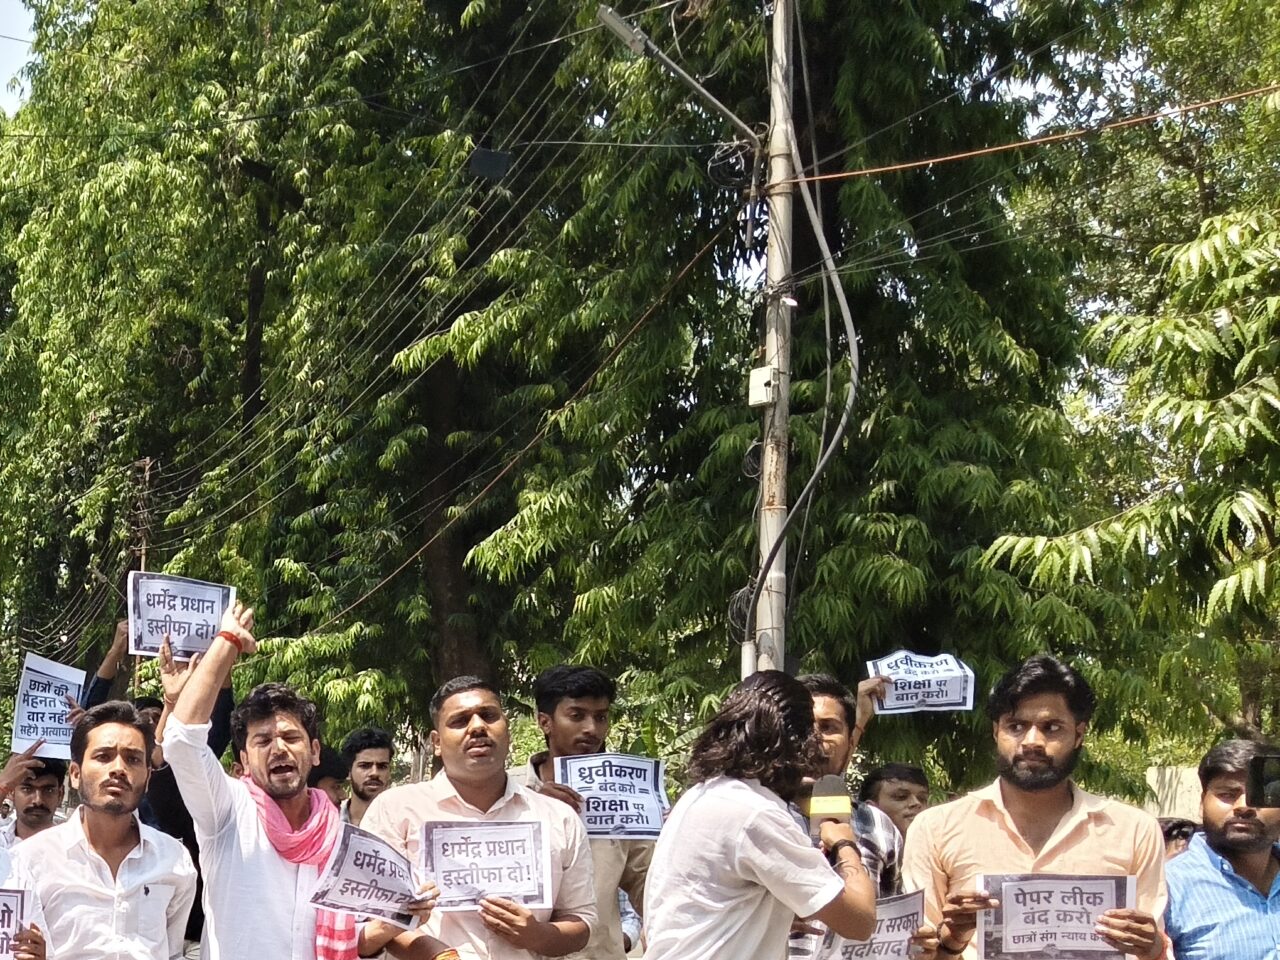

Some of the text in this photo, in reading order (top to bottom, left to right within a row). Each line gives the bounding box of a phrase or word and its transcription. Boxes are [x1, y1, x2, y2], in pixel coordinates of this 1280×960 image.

[146, 589, 215, 614] धर्मेंद्र प्रधान
[147, 614, 216, 640] इस्तीफा दो!
[29, 679, 70, 697] छात्रों की
[894, 678, 947, 691] शिक्षा पर
[22, 689, 56, 708] मेहनत
[895, 691, 920, 701] बात
[26, 711, 46, 722] वार
[578, 760, 647, 784] ध्रुवीकरण
[598, 780, 636, 794] बंद करो
[585, 796, 645, 812] शिक्षा पर
[586, 812, 650, 825] बात करो।
[441, 836, 526, 858] धर्मेंद्र प्रधान
[353, 849, 387, 877] धर्मेंद्र
[442, 861, 531, 889] इस्तीफा दो!
[339, 879, 397, 902] इस्तीफा
[1014, 886, 1104, 907] पेपर लीक
[886, 911, 919, 933] सरकार
[1022, 906, 1051, 925] बंद
[1012, 931, 1037, 944] छात्रों
[1039, 930, 1057, 943] संग
[1061, 931, 1087, 942] न्याय
